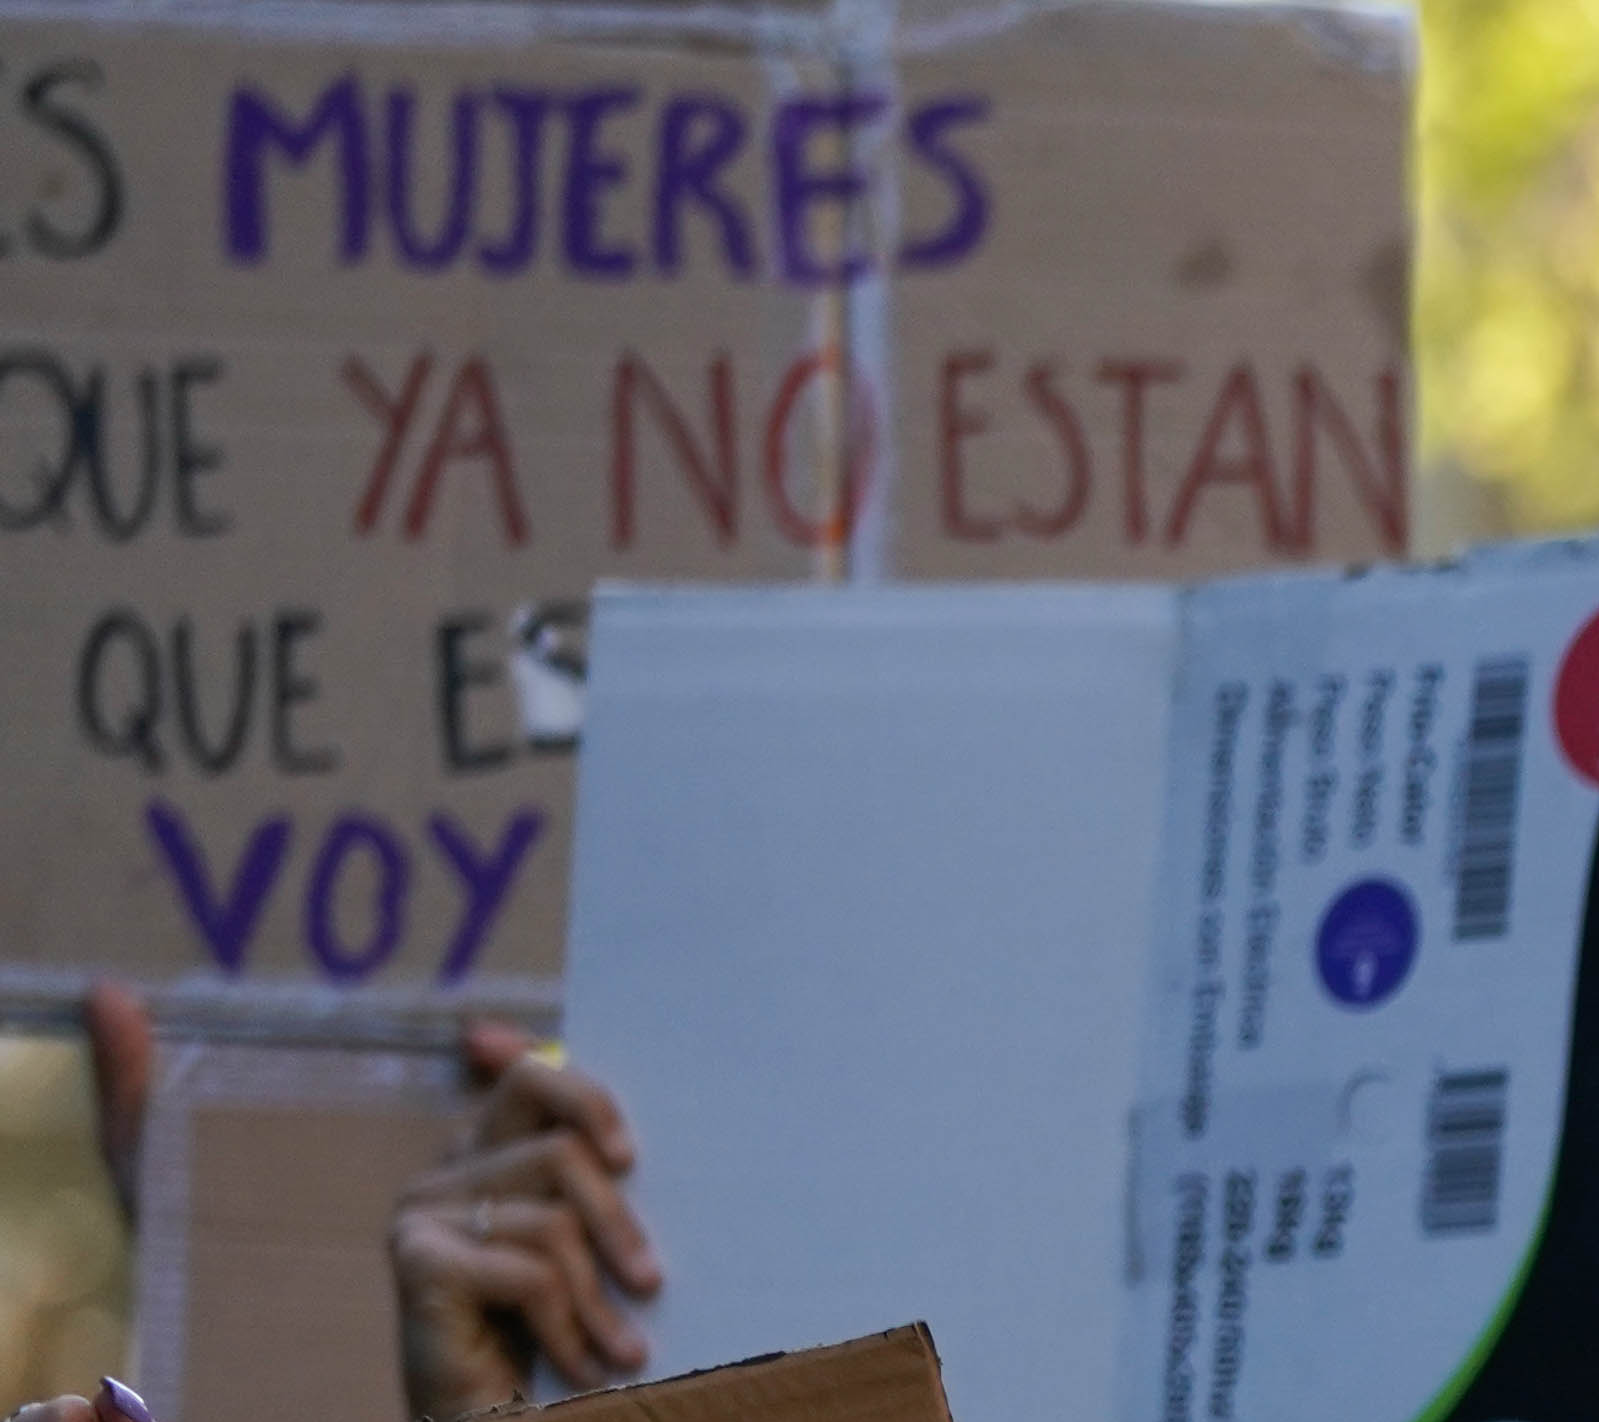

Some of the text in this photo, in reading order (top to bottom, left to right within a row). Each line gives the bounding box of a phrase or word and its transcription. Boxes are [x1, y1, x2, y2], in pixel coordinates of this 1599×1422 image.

[221, 68, 995, 288] MUJERES
[0, 342, 1412, 558] QUE YA NO ESTAN
[75, 605, 340, 779] QUE
[147, 798, 547, 989] VOY
